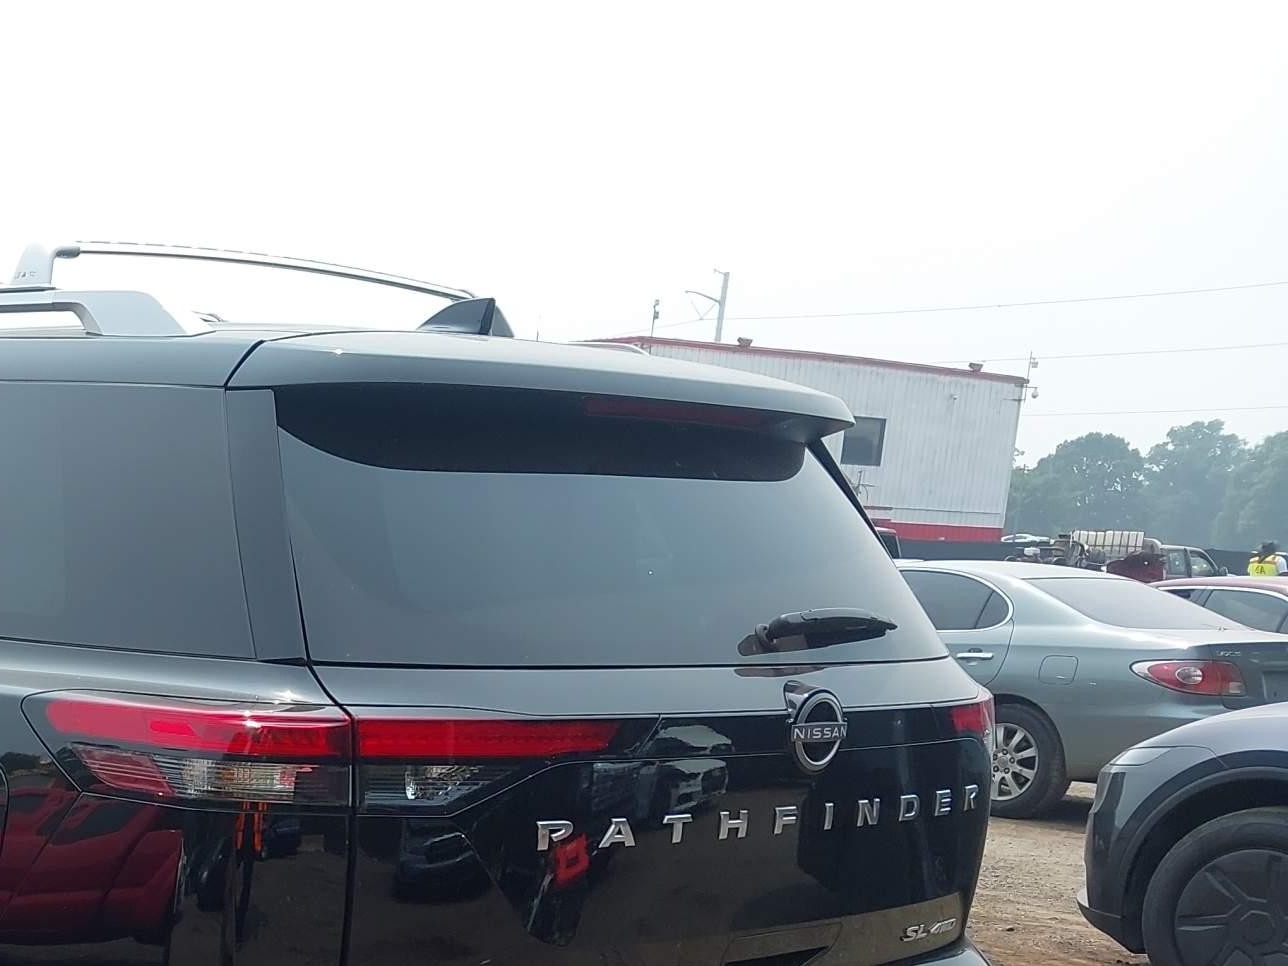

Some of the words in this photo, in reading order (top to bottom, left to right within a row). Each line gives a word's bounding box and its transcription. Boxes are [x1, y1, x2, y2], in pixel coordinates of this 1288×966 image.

[793, 726, 848, 740] NISSAN
[535, 783, 980, 852] PATHFINDER
[900, 923, 928, 943] SL
